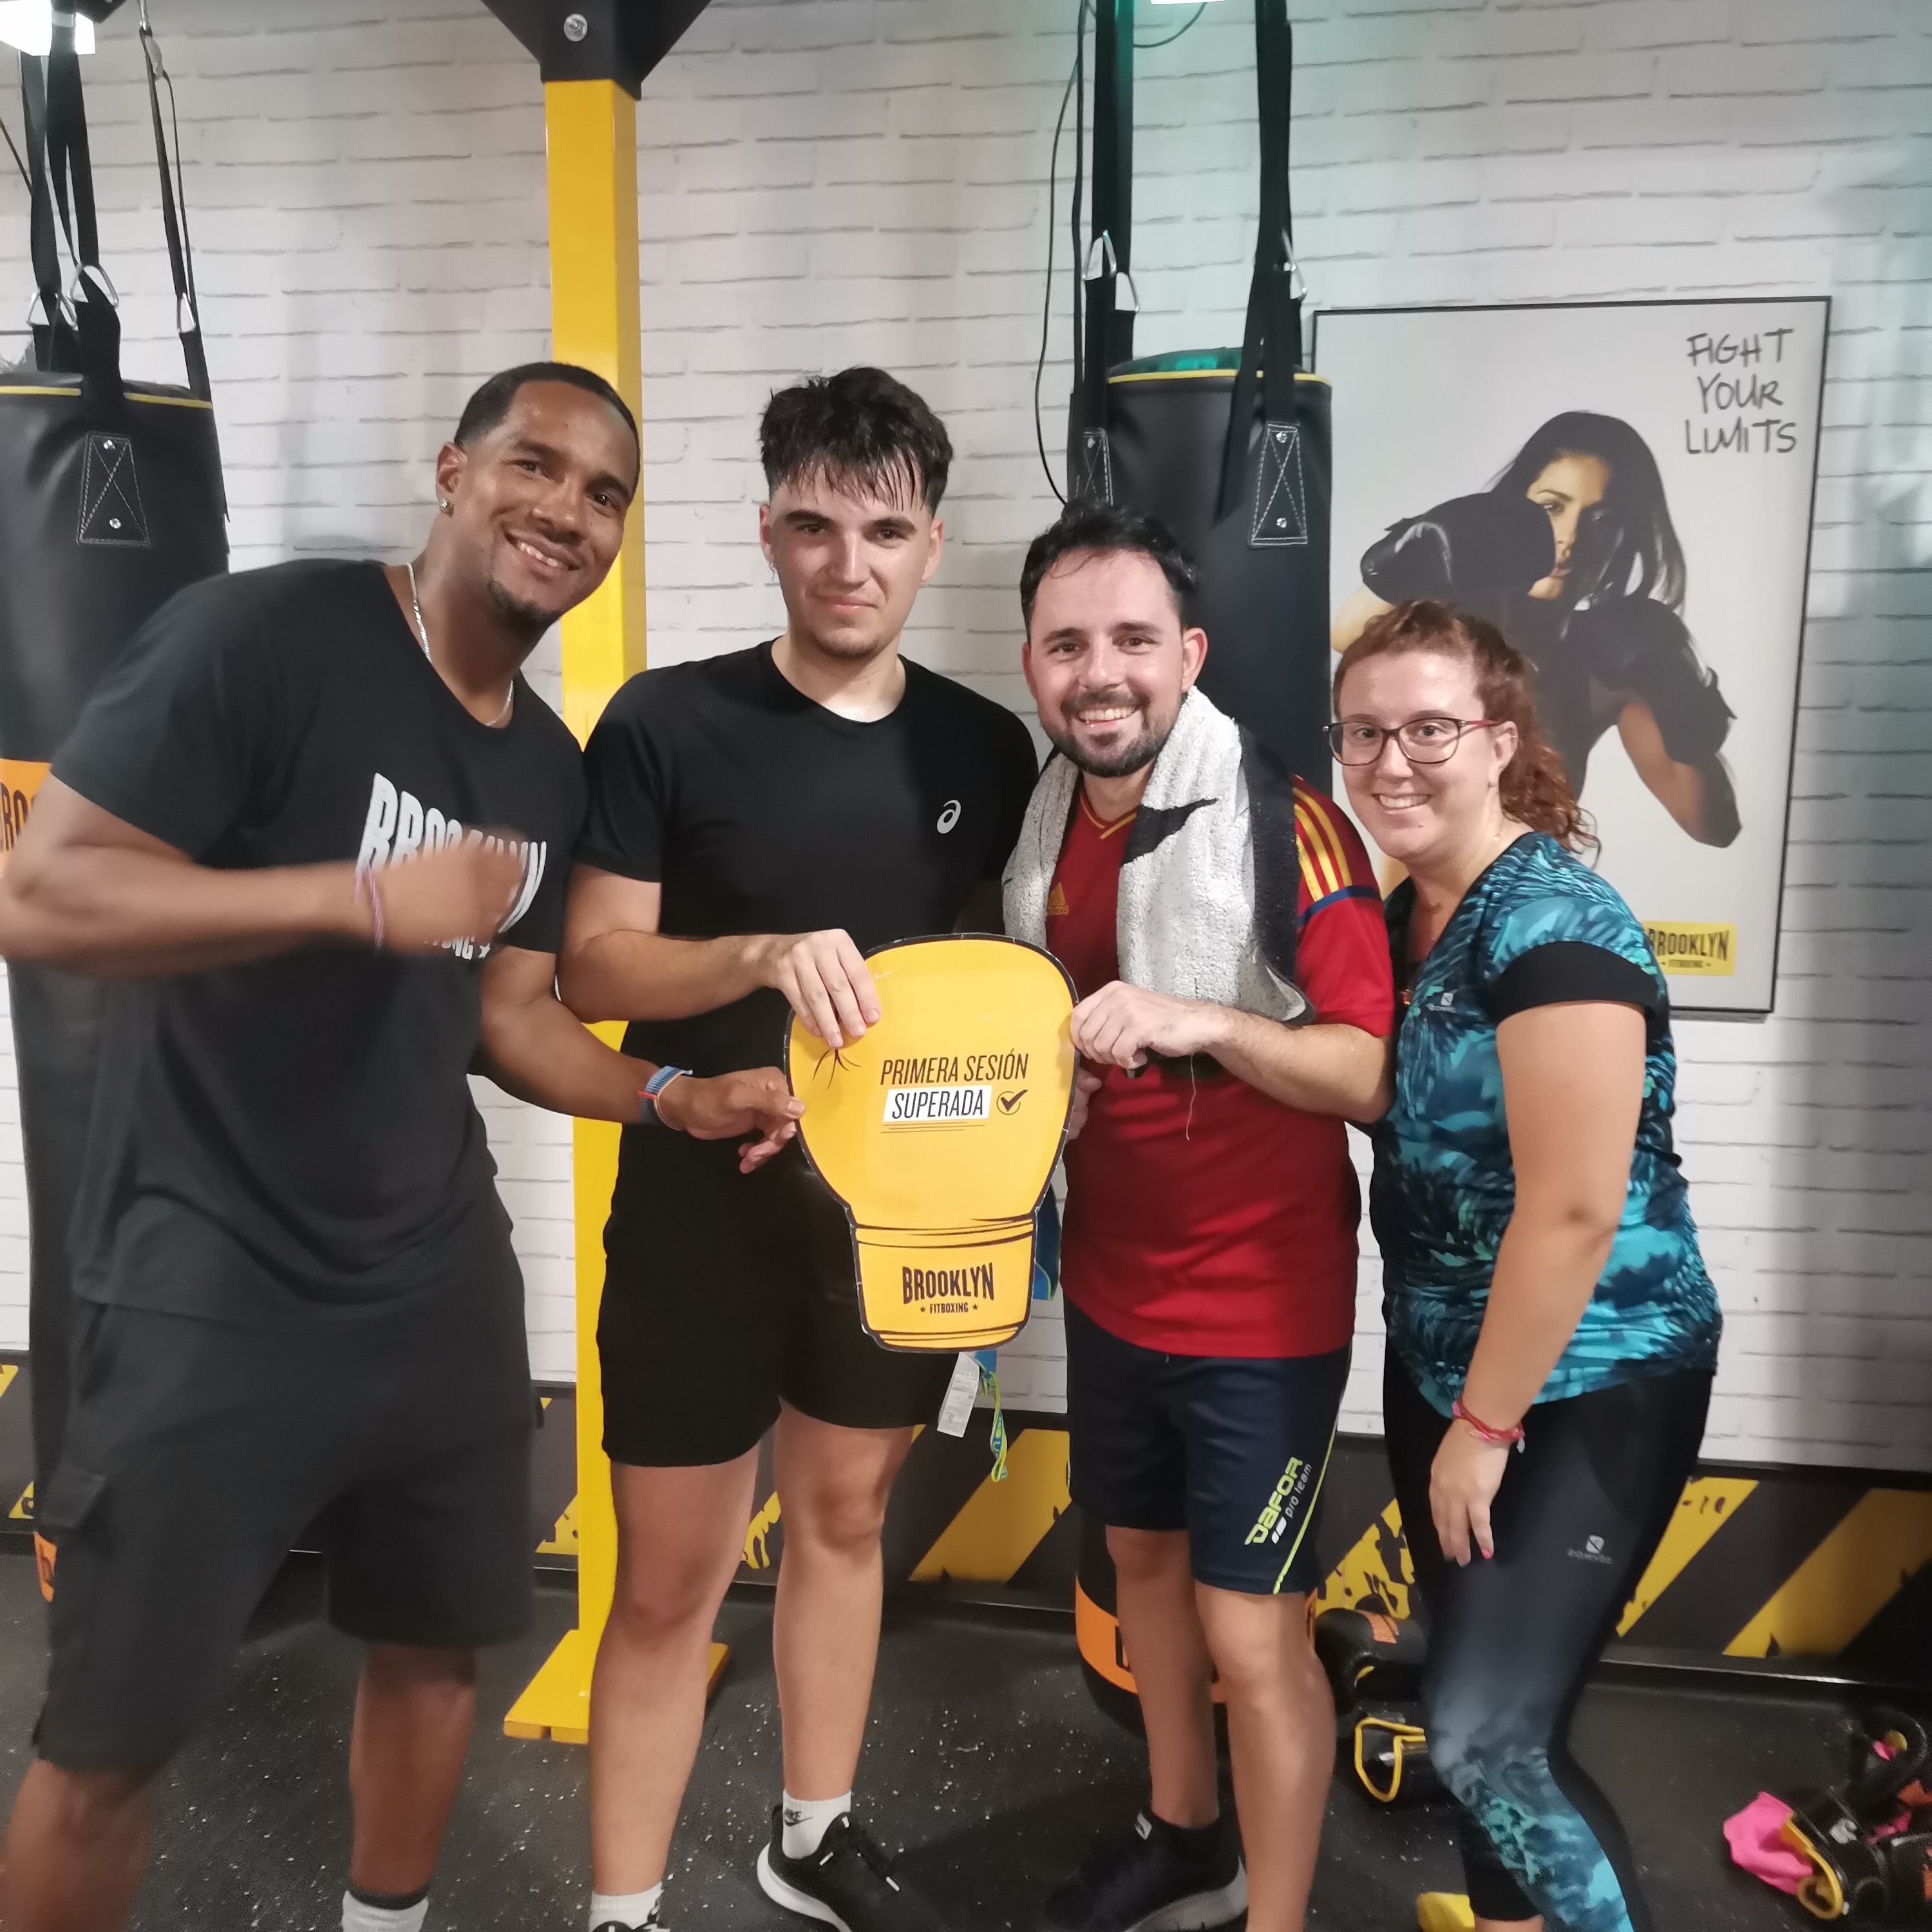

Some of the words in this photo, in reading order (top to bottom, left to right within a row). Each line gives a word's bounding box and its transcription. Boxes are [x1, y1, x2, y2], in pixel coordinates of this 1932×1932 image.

[1686, 328, 1794, 367] FIGHT
[1697, 372, 1783, 414] YOUR
[1685, 416, 1796, 455] LIMITS
[880, 1056, 958, 1086] PRIMERA
[963, 1048, 1029, 1082] SESIÓN
[892, 1089, 983, 1119] SUPERADA
[902, 1262, 994, 1305] BROOKLYN
[930, 1302, 969, 1314] FITBOXING
